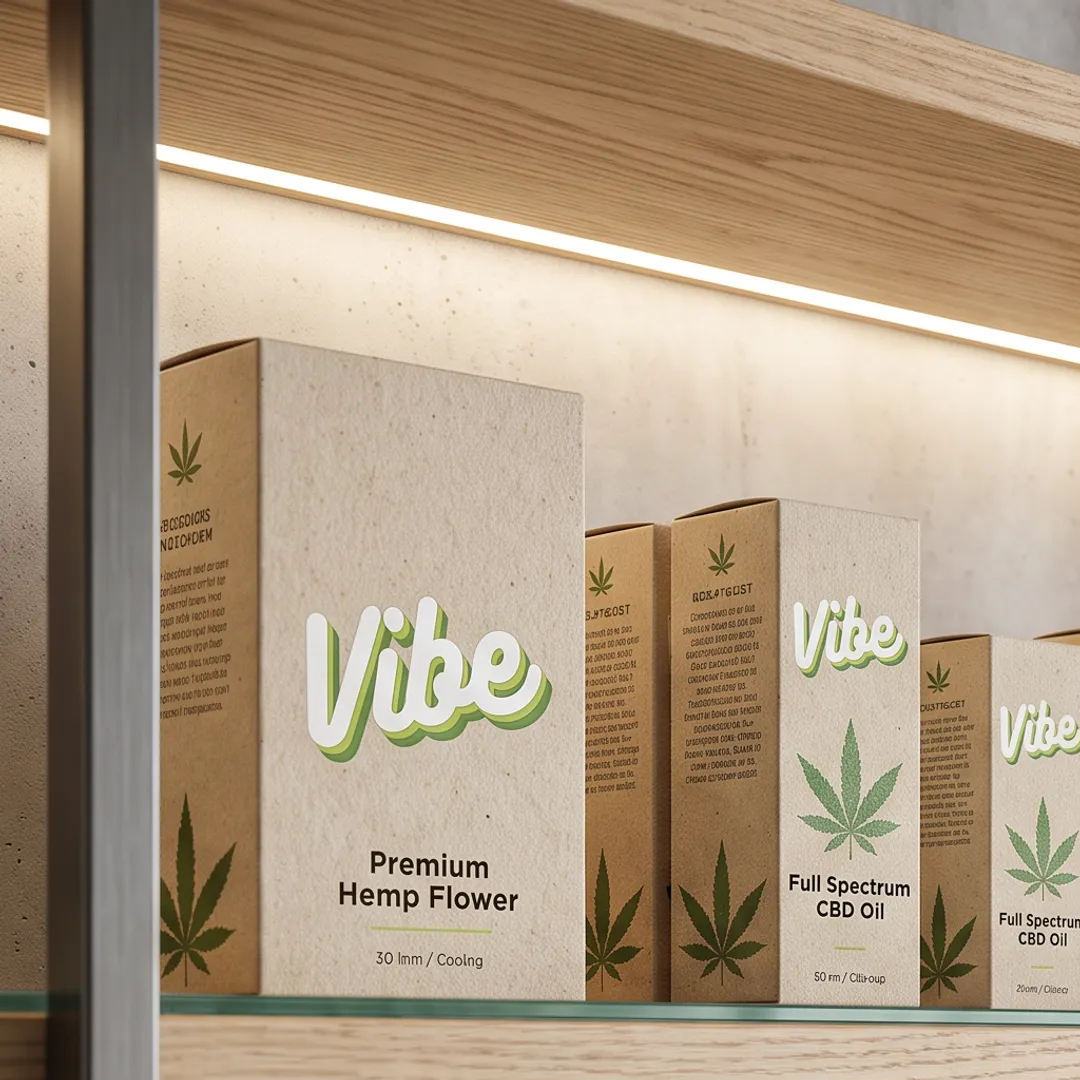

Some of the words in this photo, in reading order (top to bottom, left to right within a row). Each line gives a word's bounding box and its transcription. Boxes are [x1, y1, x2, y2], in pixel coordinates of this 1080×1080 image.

[794, 595, 908, 678] Vibe
[306, 596, 553, 763] Vibe
[370, 850, 489, 879] Premium
[339, 881, 420, 913] Hemp
[429, 884, 519, 911] Flower
[788, 873, 821, 892] Full
[826, 875, 911, 898] Spectrum
[816, 900, 855, 918] CBD
[860, 902, 885, 920] Oil
[999, 912, 1022, 926] Full
[1018, 931, 1046, 946] CBD
[1049, 932, 1068, 947] Oil
[375, 951, 394, 965] 30
